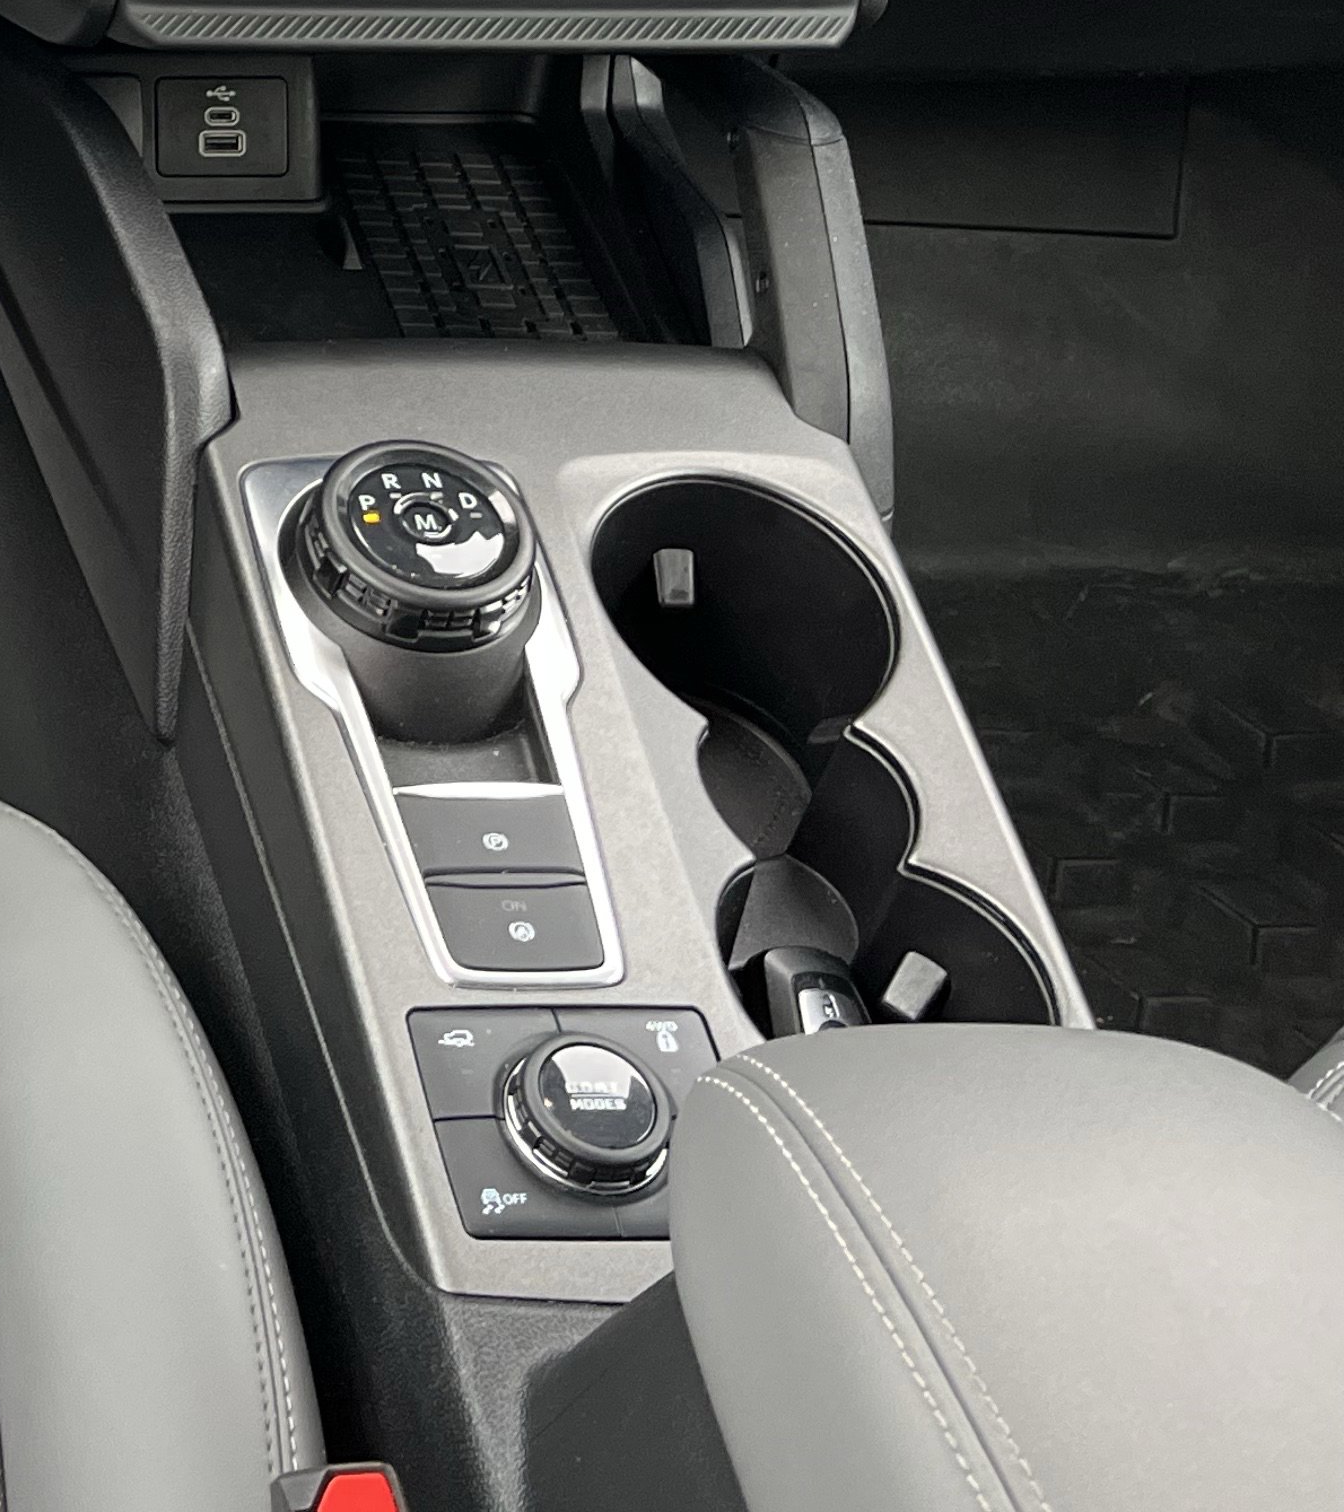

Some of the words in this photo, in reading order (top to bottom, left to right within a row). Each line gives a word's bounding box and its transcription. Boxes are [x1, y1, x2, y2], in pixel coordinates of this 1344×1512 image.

[358, 494, 376, 511] P
[381, 473, 402, 489] R
[421, 472, 444, 489] N
[458, 492, 478, 509] D
[569, 1097, 628, 1111] MODES
[502, 1192, 528, 1205] OFF
